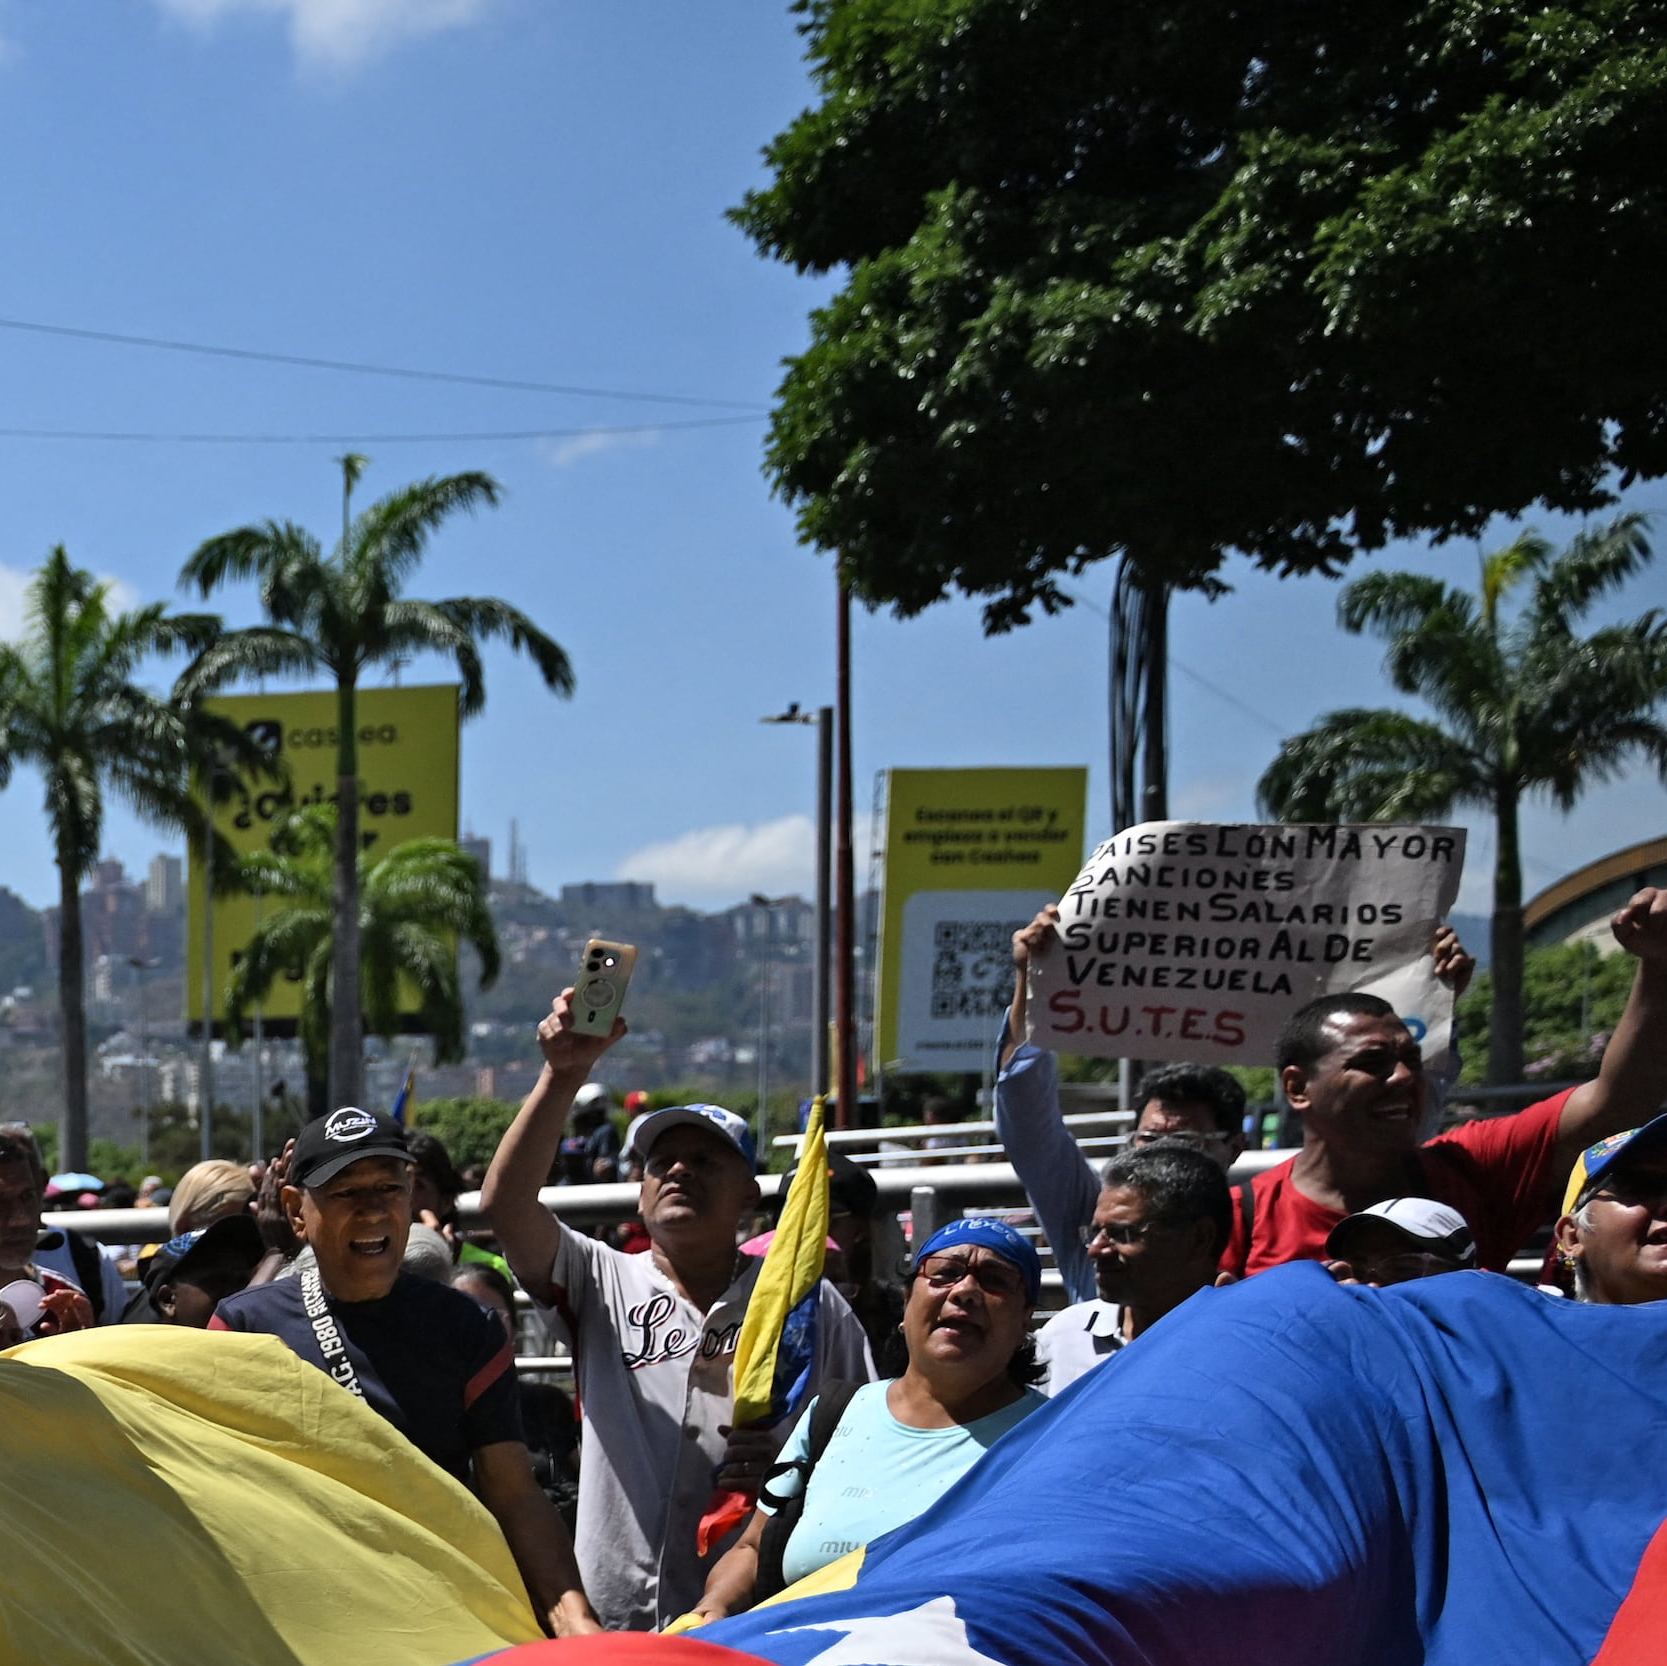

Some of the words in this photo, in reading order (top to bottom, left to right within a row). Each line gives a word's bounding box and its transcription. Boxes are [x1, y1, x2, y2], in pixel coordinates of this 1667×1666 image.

[288, 724, 397, 748] casea
[1088, 832, 1207, 861] PAISES
[1215, 827, 1295, 859] CON
[1305, 826, 1456, 862] MAYOR
[1071, 863, 1295, 892] SANCIONES
[1070, 890, 1201, 922] TIENEN
[1208, 893, 1402, 925] SALARIOS
[1064, 923, 1260, 960] SUPERIOR
[1268, 930, 1315, 962] AL
[1323, 934, 1373, 963] DE
[1067, 956, 1292, 996] VENEZUELA
[312, 1314, 345, 1359] 1980
